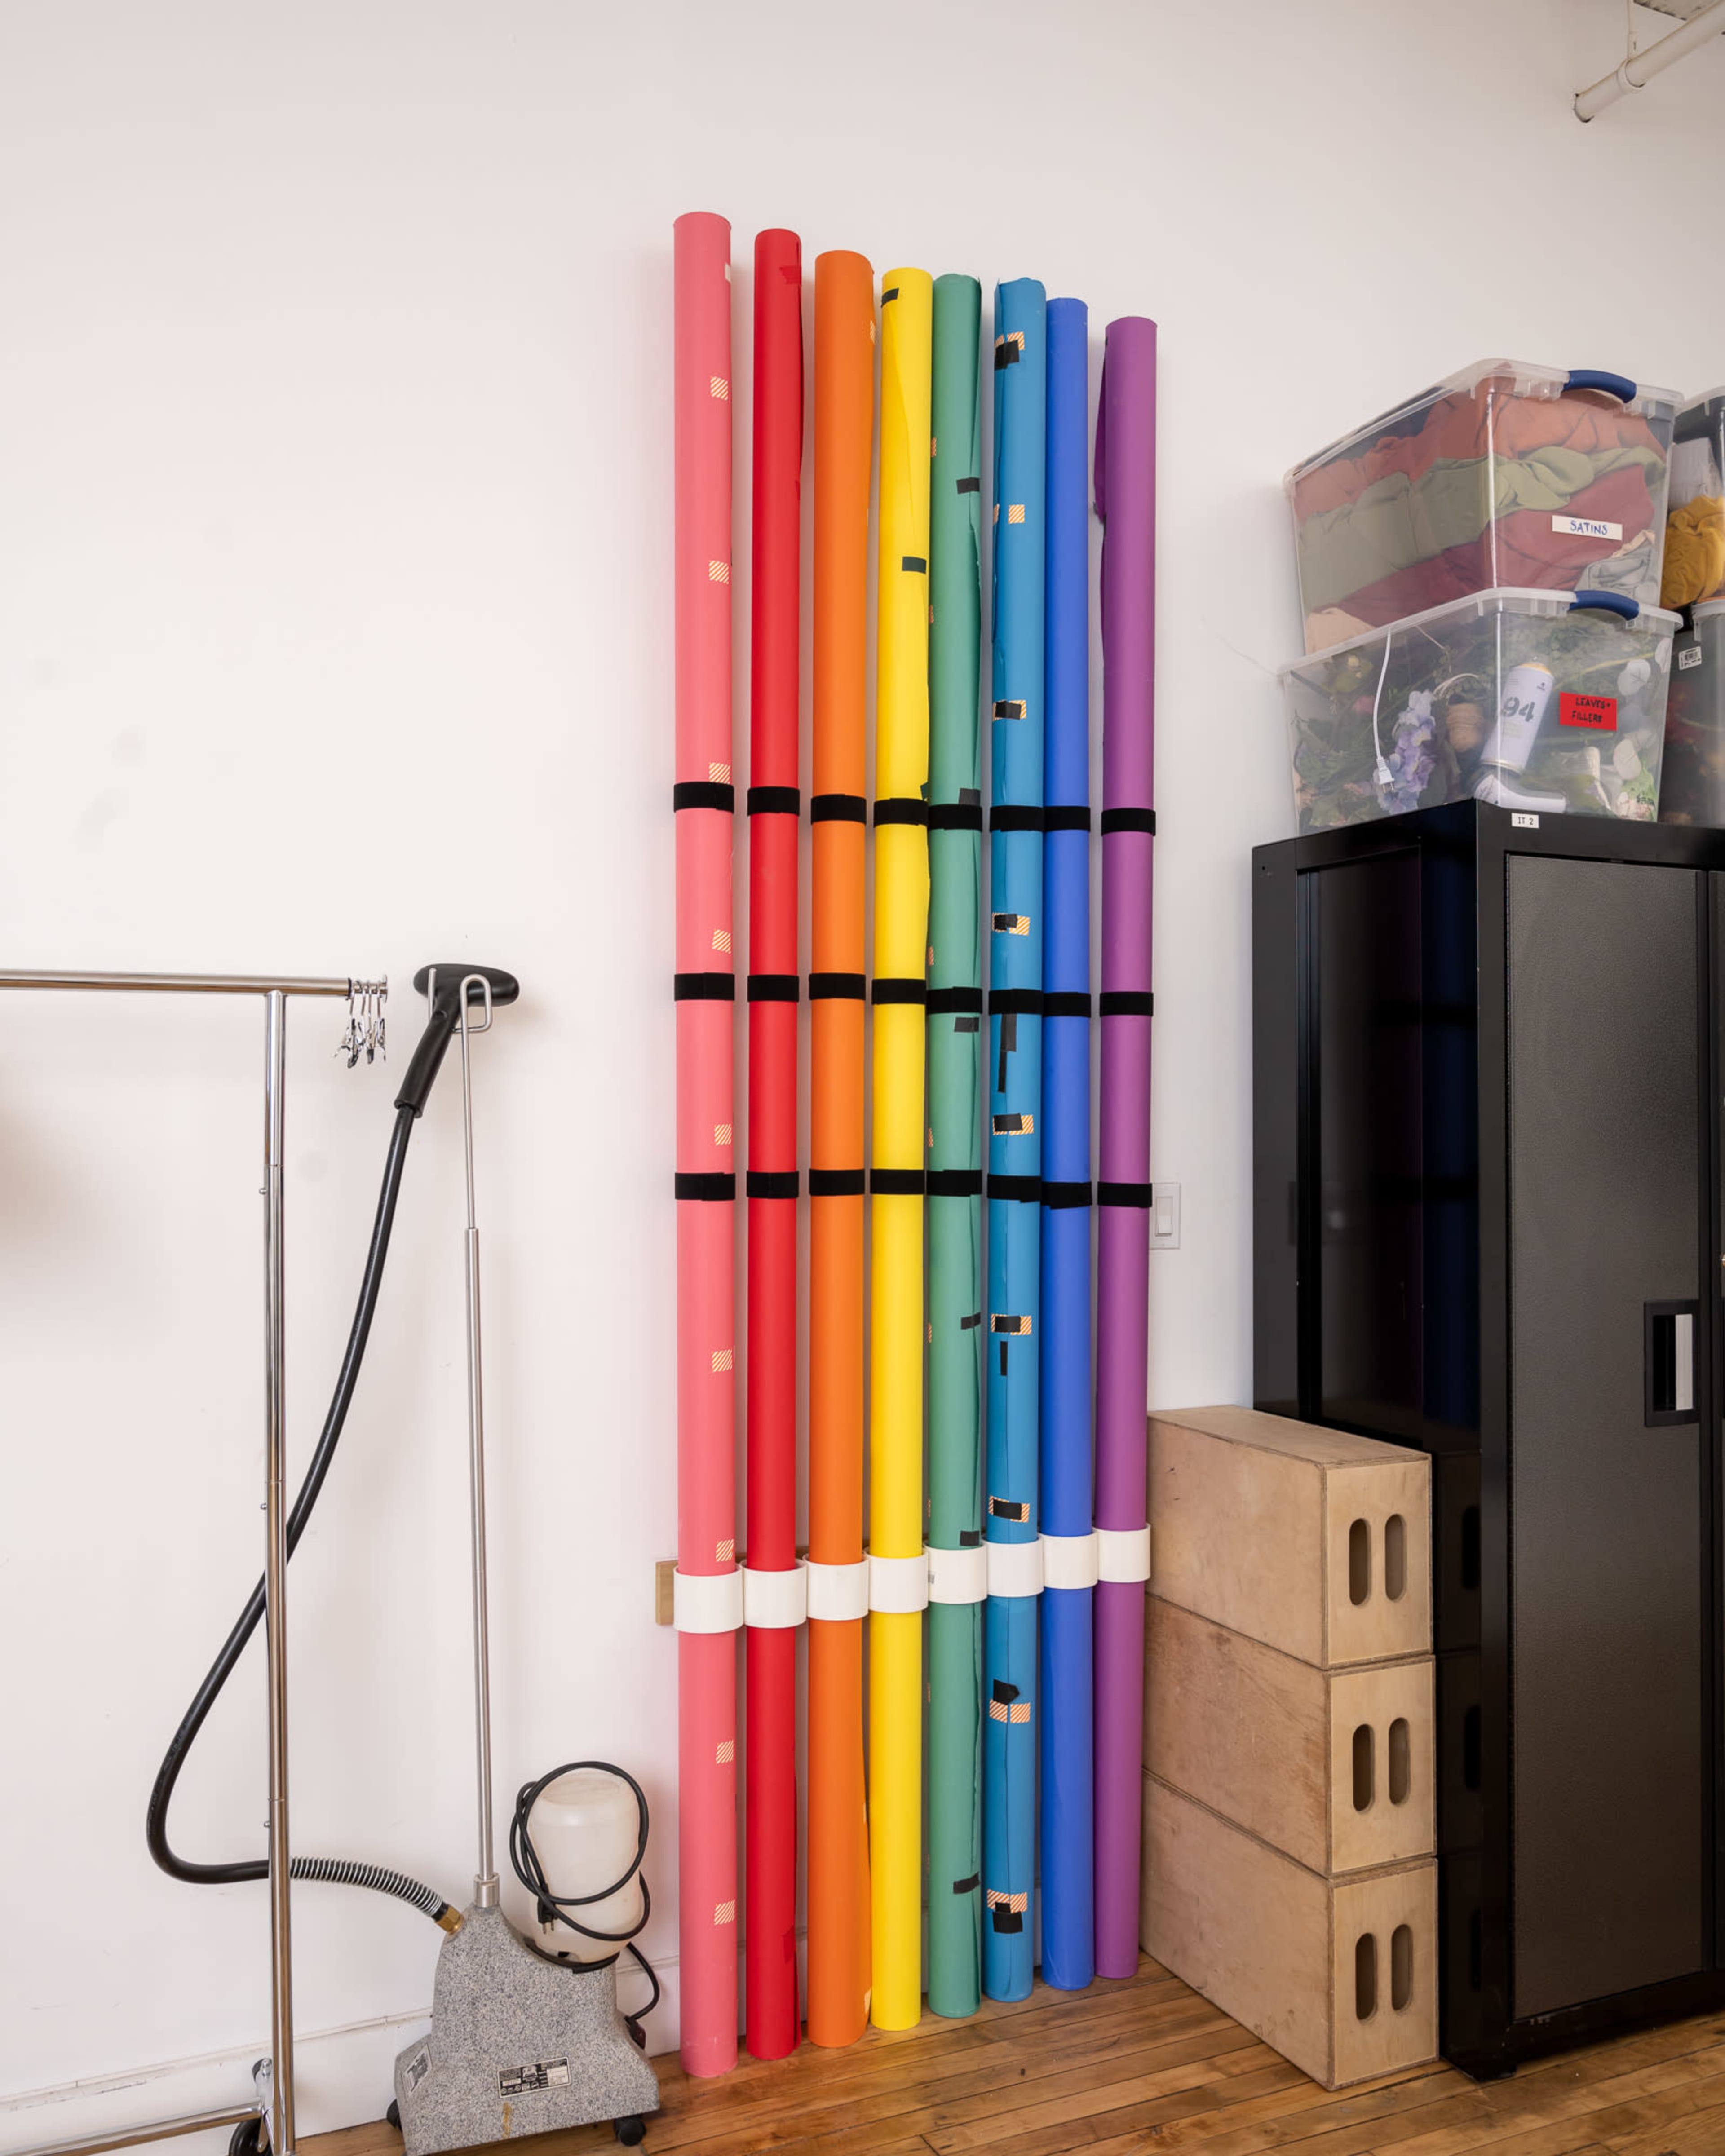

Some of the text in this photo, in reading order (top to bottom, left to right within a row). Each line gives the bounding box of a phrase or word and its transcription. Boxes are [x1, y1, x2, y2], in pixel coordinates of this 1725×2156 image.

[1570, 520, 1608, 535] SATINS
[1501, 697, 1535, 722] 94
[1518, 817, 1534, 826] IT 2
